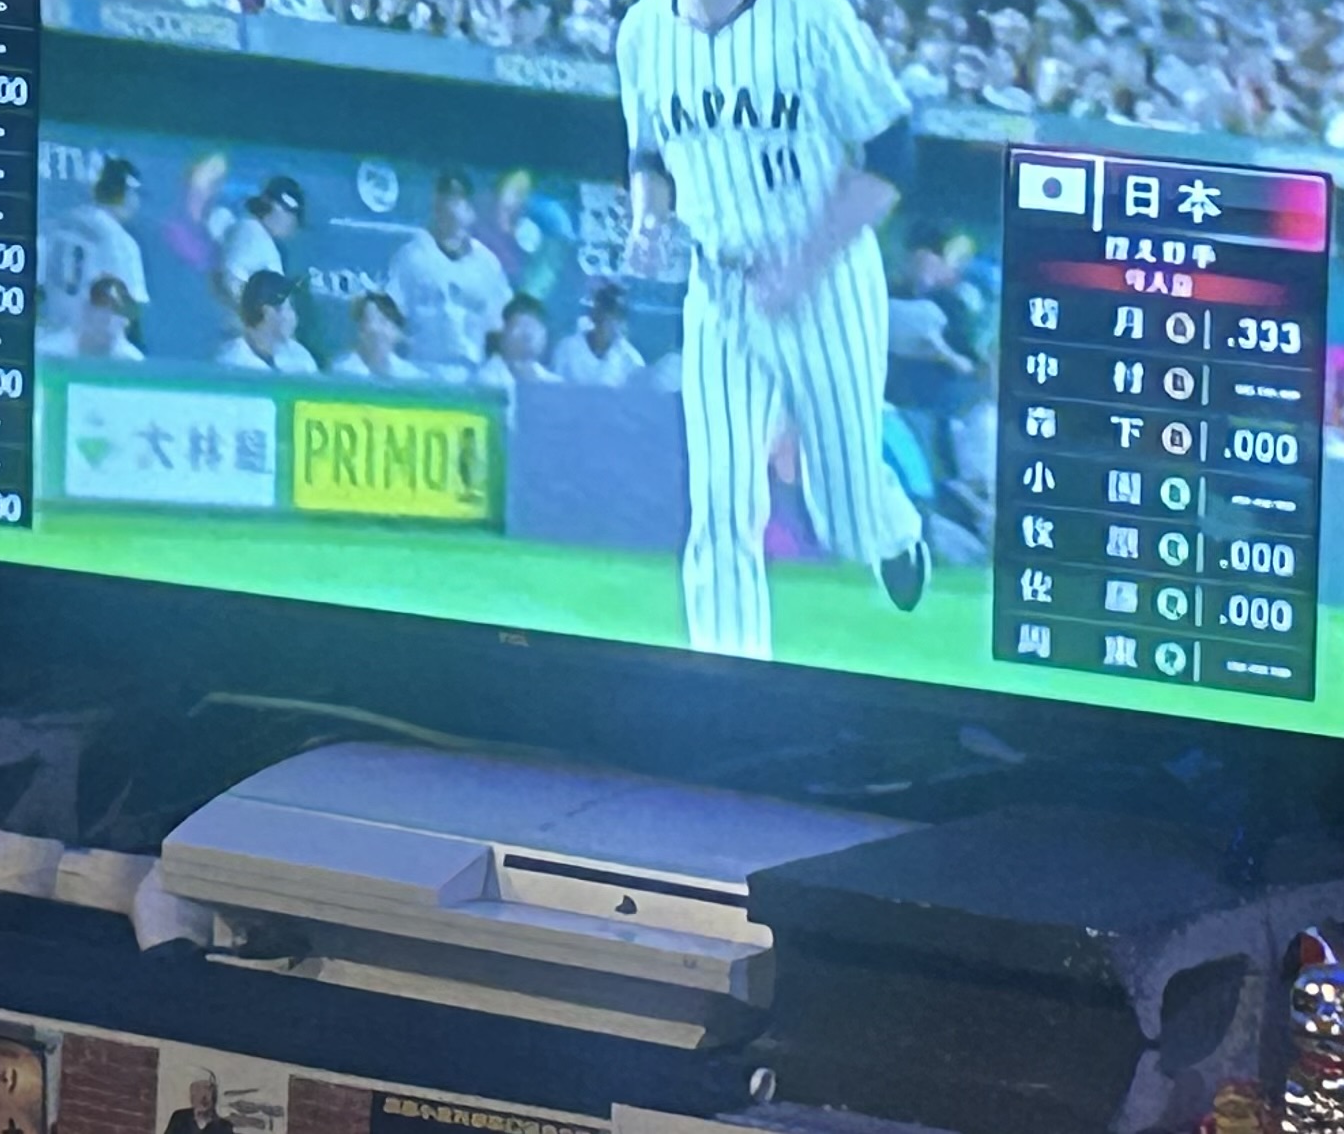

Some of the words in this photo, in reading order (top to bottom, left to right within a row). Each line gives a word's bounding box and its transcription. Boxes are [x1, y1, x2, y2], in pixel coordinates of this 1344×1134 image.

[1124, 174, 1222, 224] 日本
[1227, 317, 1302, 354] .333
[1224, 429, 1299, 466] .000
[1219, 539, 1296, 577] .000
[1219, 593, 1294, 632] .000
